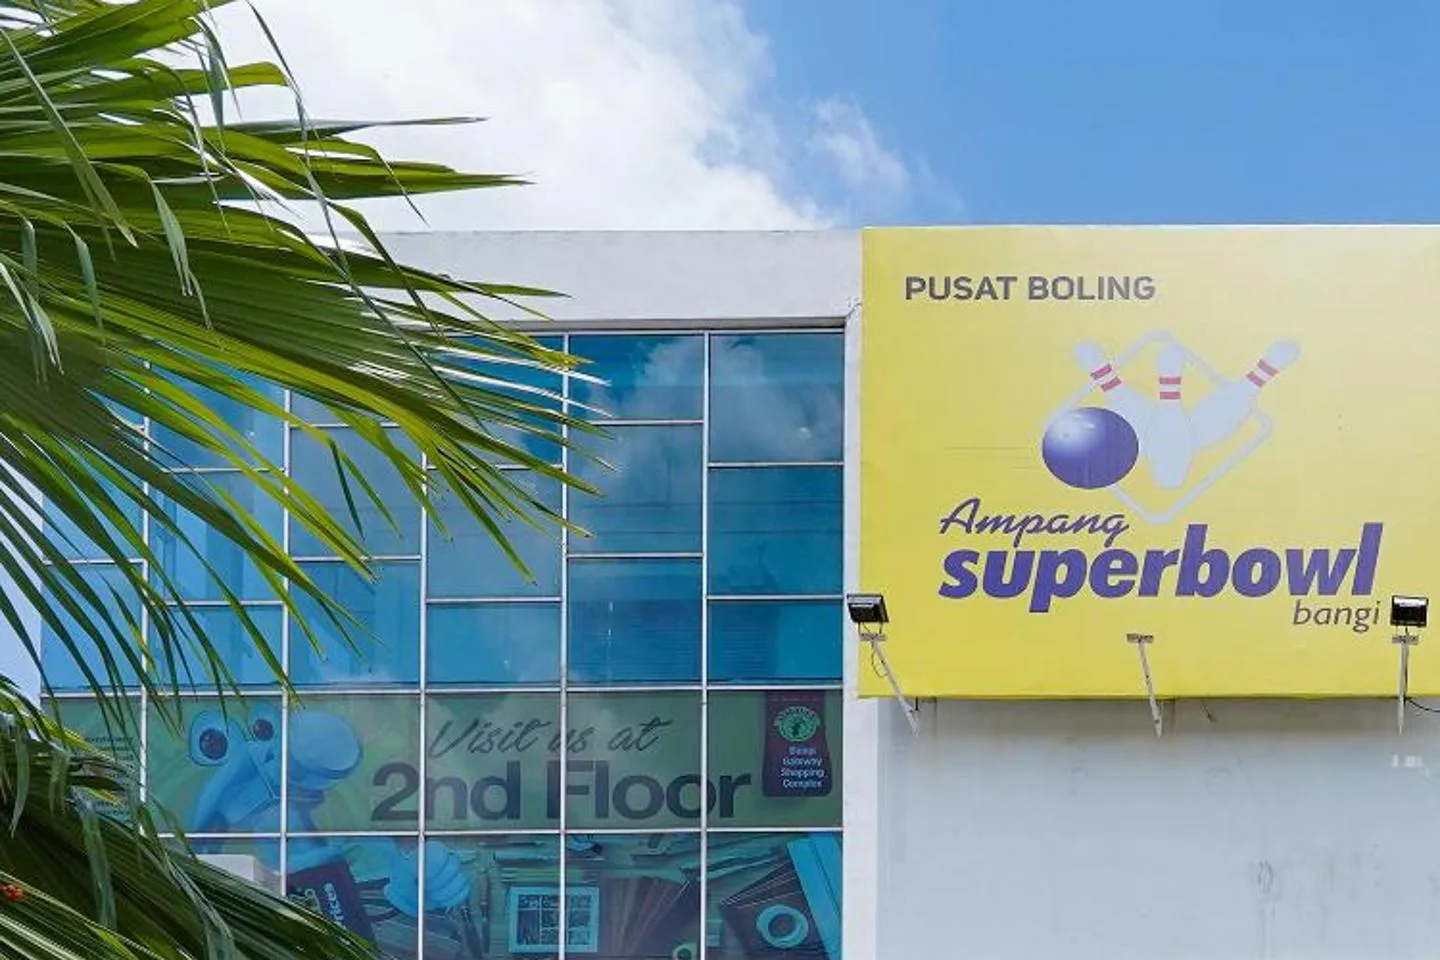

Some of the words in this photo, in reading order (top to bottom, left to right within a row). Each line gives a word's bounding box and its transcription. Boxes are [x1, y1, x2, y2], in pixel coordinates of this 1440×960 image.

[905, 276, 1017, 301] PUSAT
[1027, 276, 1156, 301] BOLING
[939, 497, 1131, 547] Ampang
[938, 522, 1384, 613] superbowl
[1293, 599, 1381, 632] bangi
[430, 718, 552, 759] Visit
[547, 725, 595, 755] us
[606, 716, 673, 752] at
[370, 759, 522, 822] 2nd
[546, 759, 752, 821] Floor
